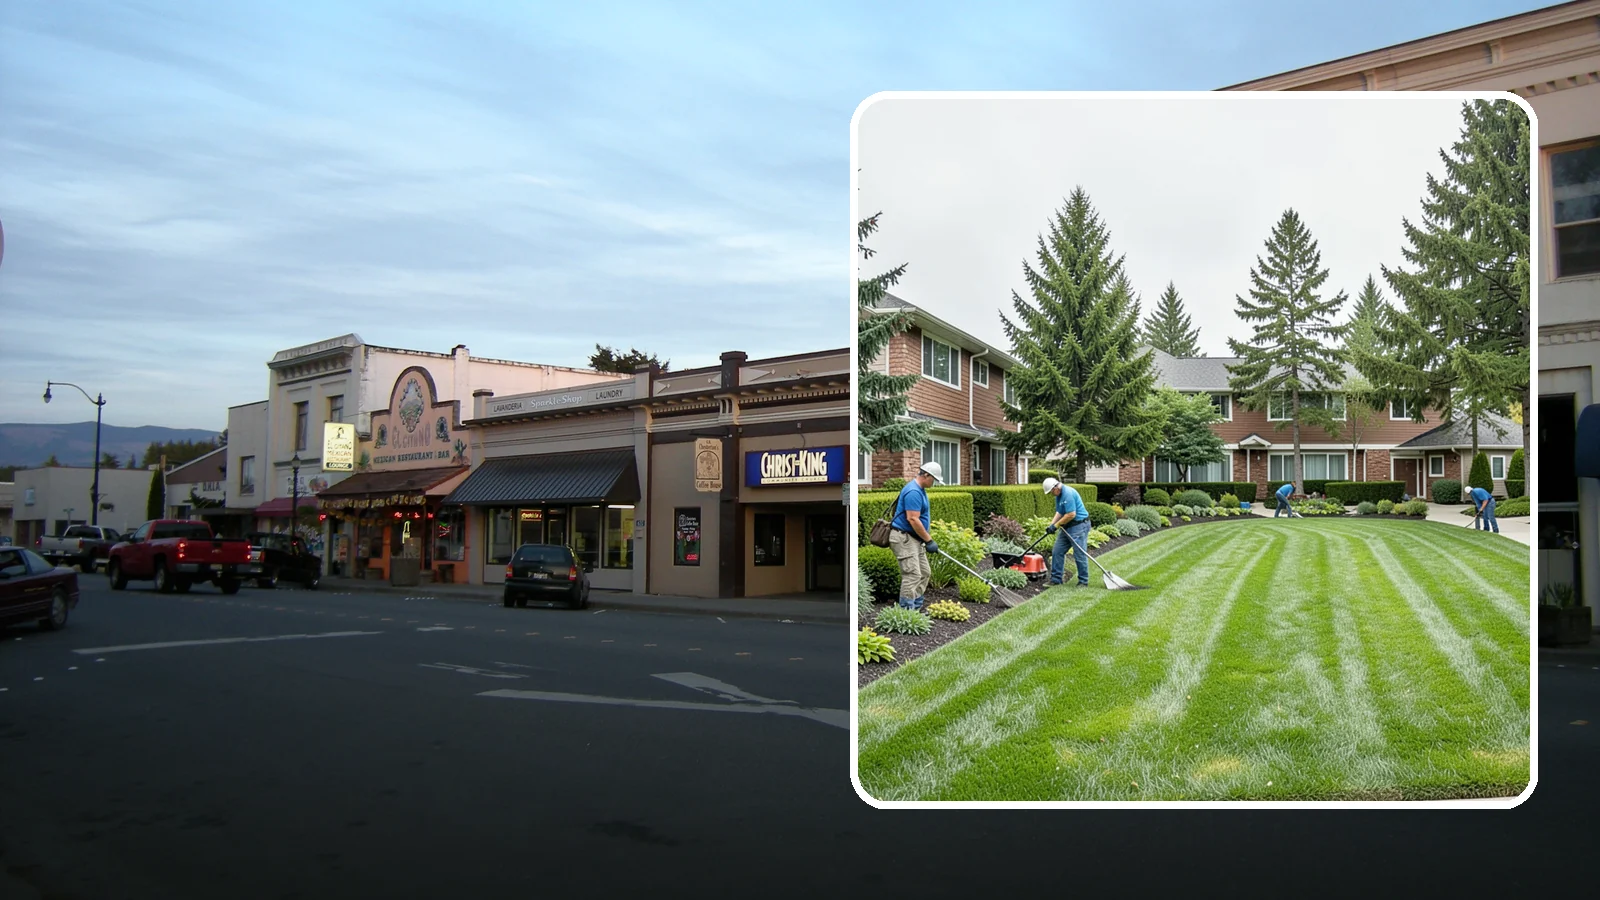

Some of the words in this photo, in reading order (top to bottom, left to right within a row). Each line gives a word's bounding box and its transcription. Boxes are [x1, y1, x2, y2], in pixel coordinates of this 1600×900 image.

[530, 396, 561, 409] Sparkle
[561, 393, 582, 405] Shop
[595, 389, 624, 400] LAUNDRY
[494, 402, 523, 413] LAVANDERIA
[392, 426, 402, 449] EL
[373, 454, 396, 464] MEXICAN
[397, 451, 434, 463] RESTAURANT
[437, 450, 450, 459] BAR
